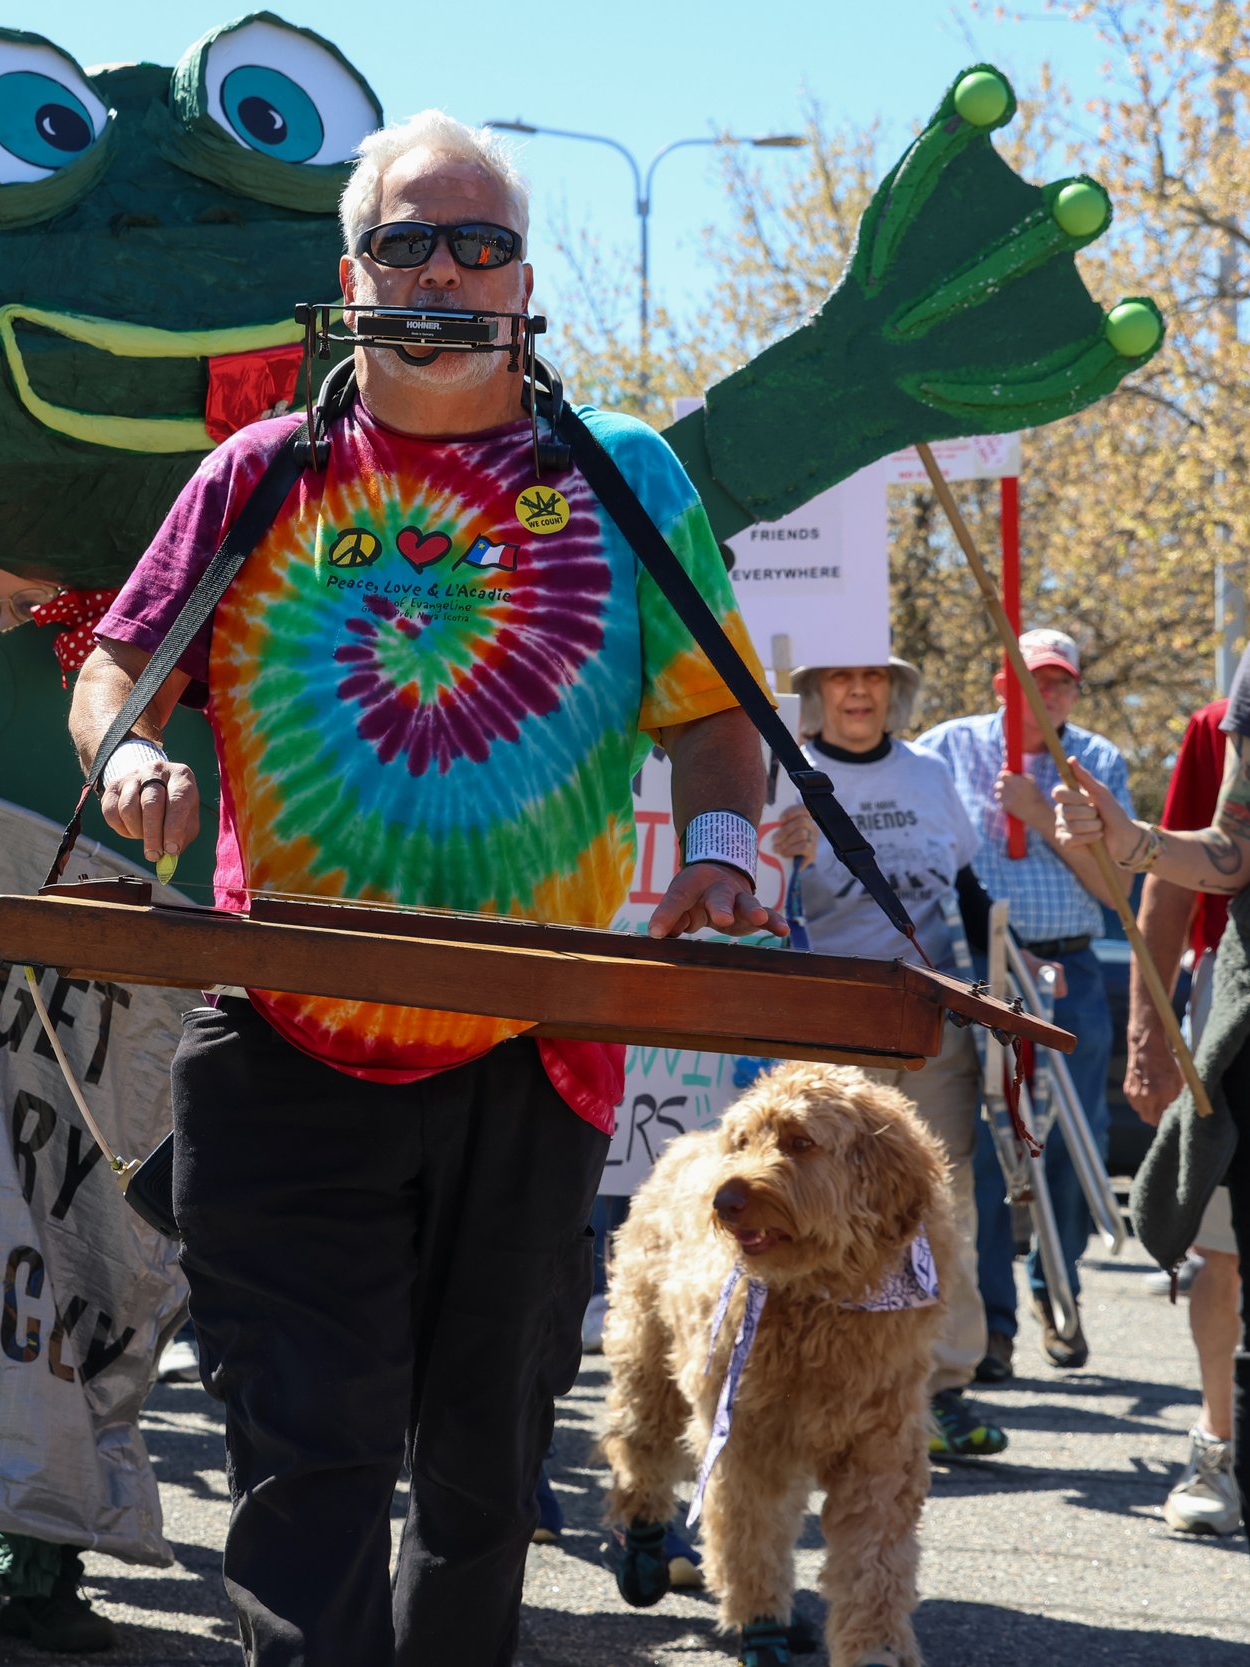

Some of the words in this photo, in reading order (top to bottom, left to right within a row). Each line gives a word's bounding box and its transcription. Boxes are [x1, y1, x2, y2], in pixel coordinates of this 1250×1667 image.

[541, 517, 563, 526] COUNT
[751, 528, 819, 541] FRIENDS
[731, 566, 841, 581] EVERYWHERE
[327, 575, 379, 593] Peace,
[384, 580, 422, 597] Love
[427, 583, 438, 598] &
[445, 584, 512, 603] L'Acadie
[411, 597, 472, 613] Evangeline
